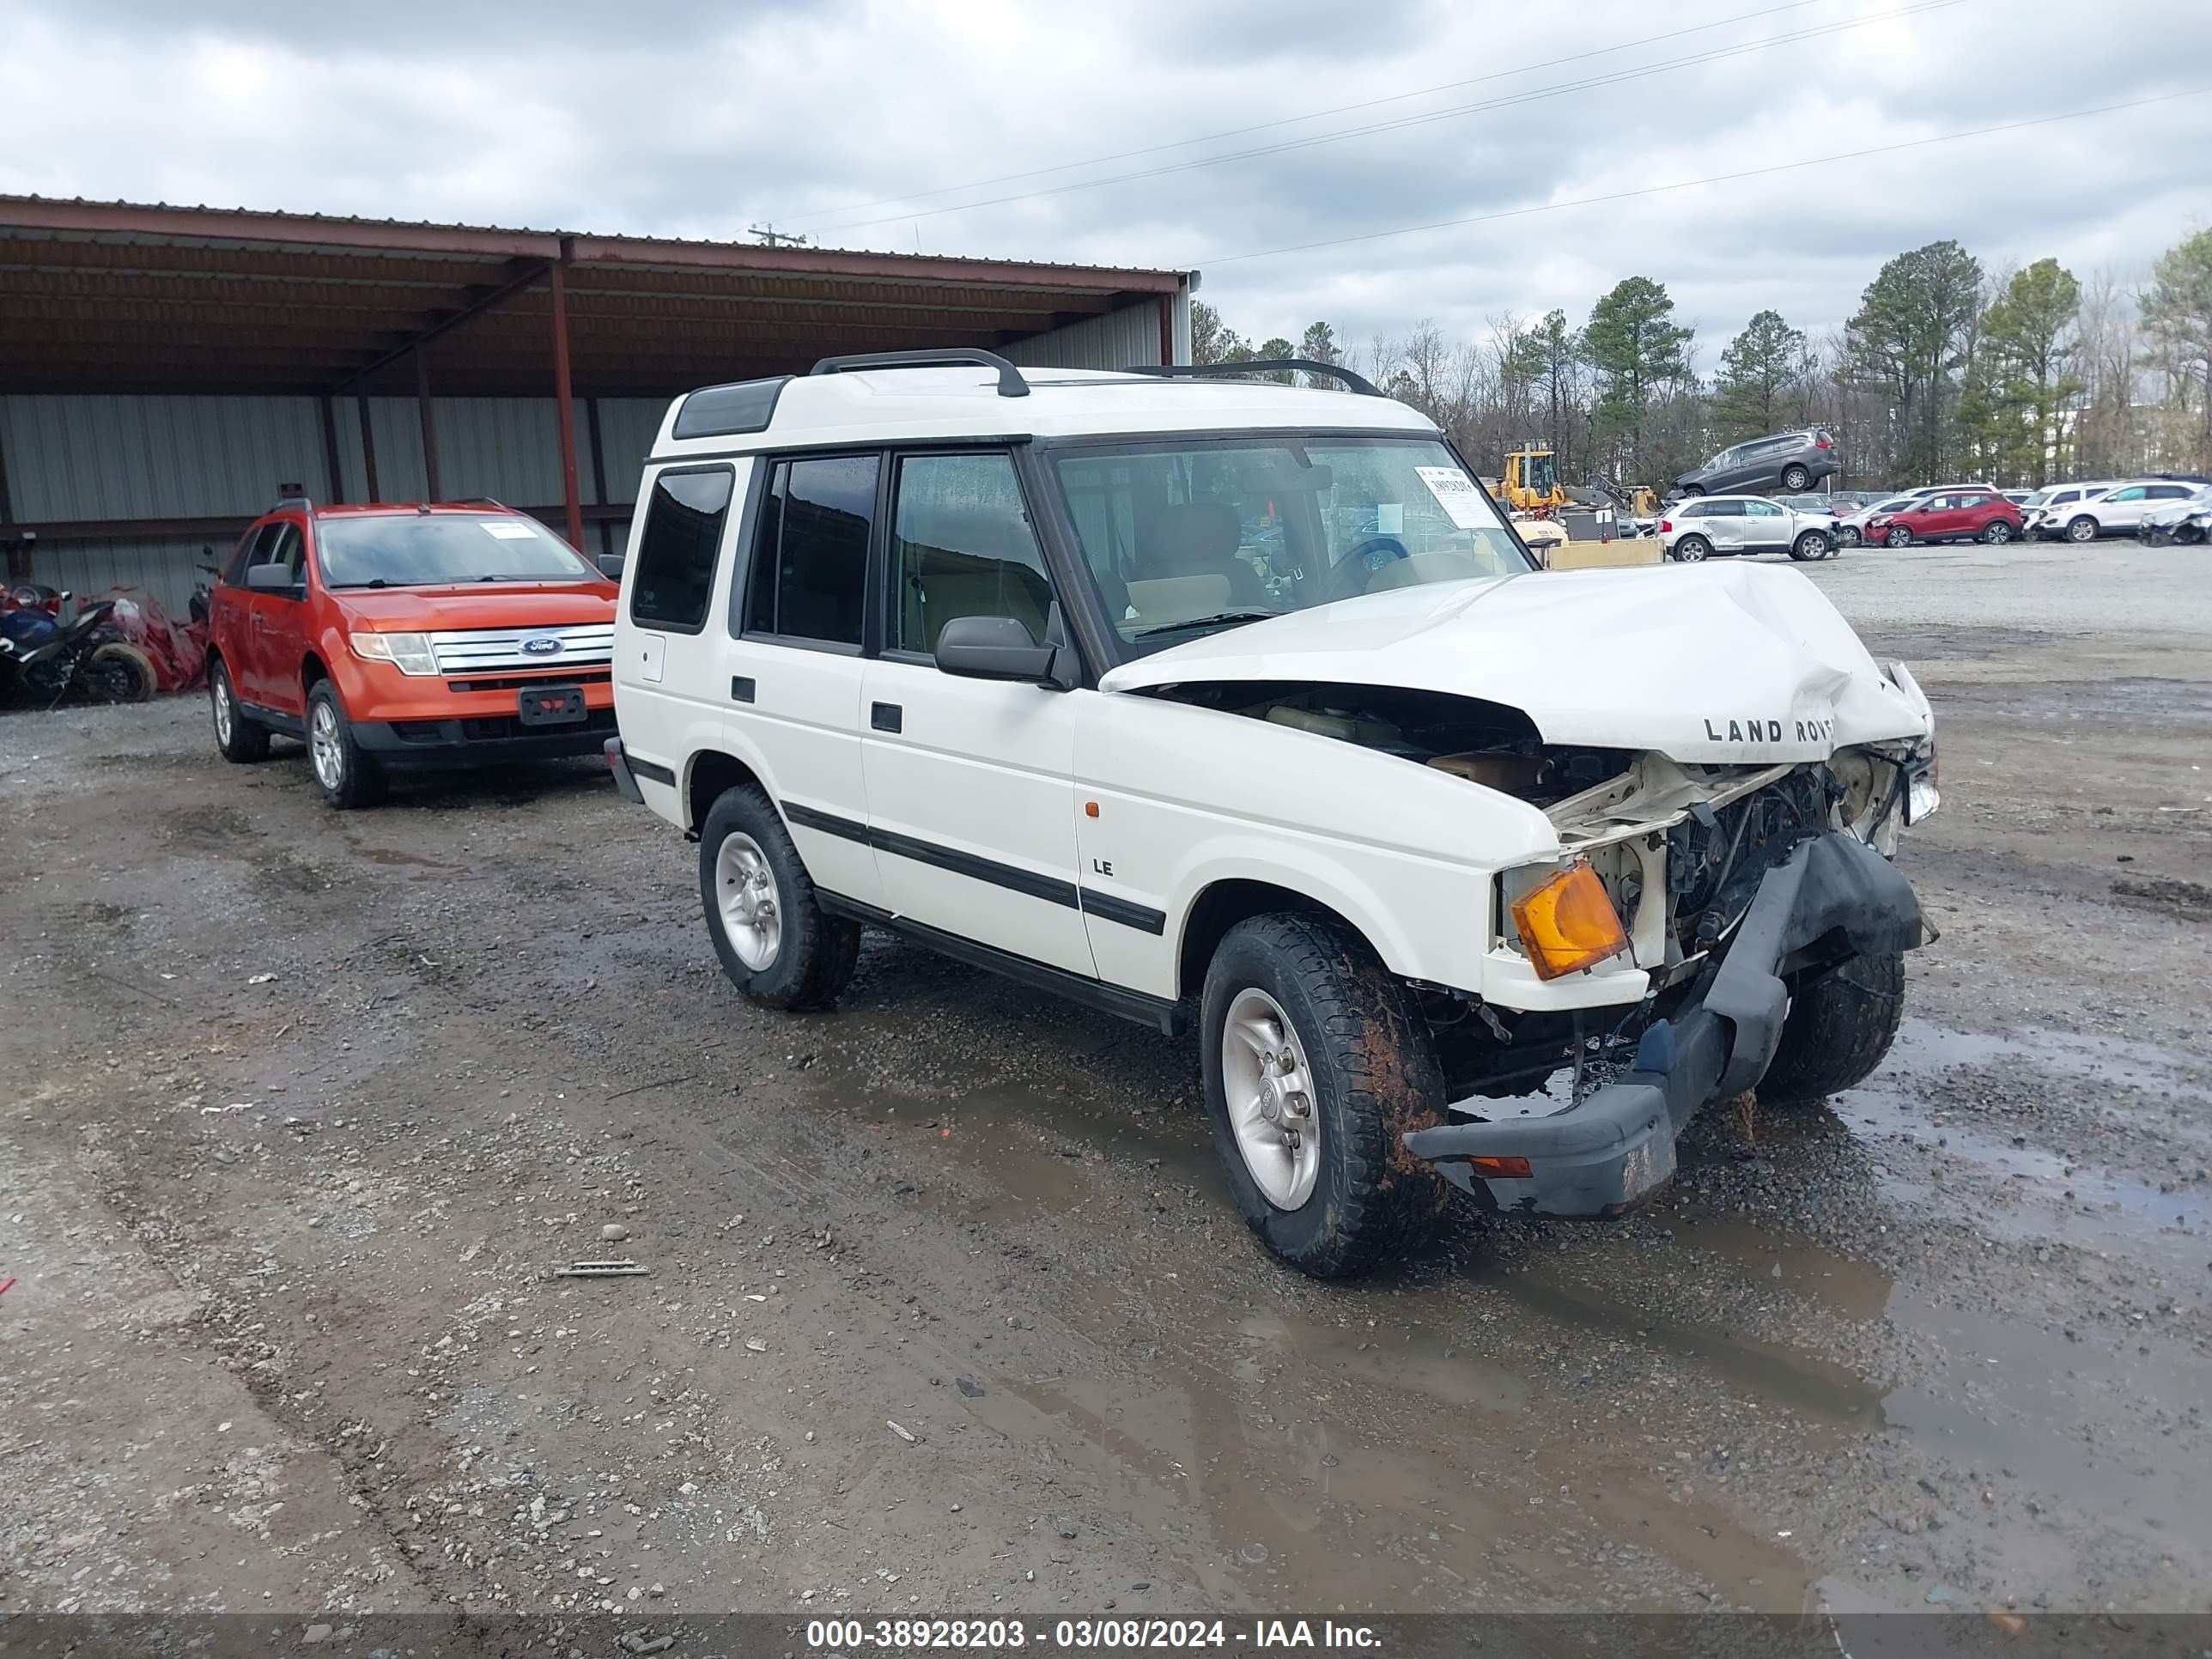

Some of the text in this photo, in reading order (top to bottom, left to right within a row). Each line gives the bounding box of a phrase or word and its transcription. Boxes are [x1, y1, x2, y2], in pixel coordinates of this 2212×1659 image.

[531, 640, 555, 651] Ford
[1704, 719, 1782, 743] LAND
[1093, 858, 1114, 877] LE
